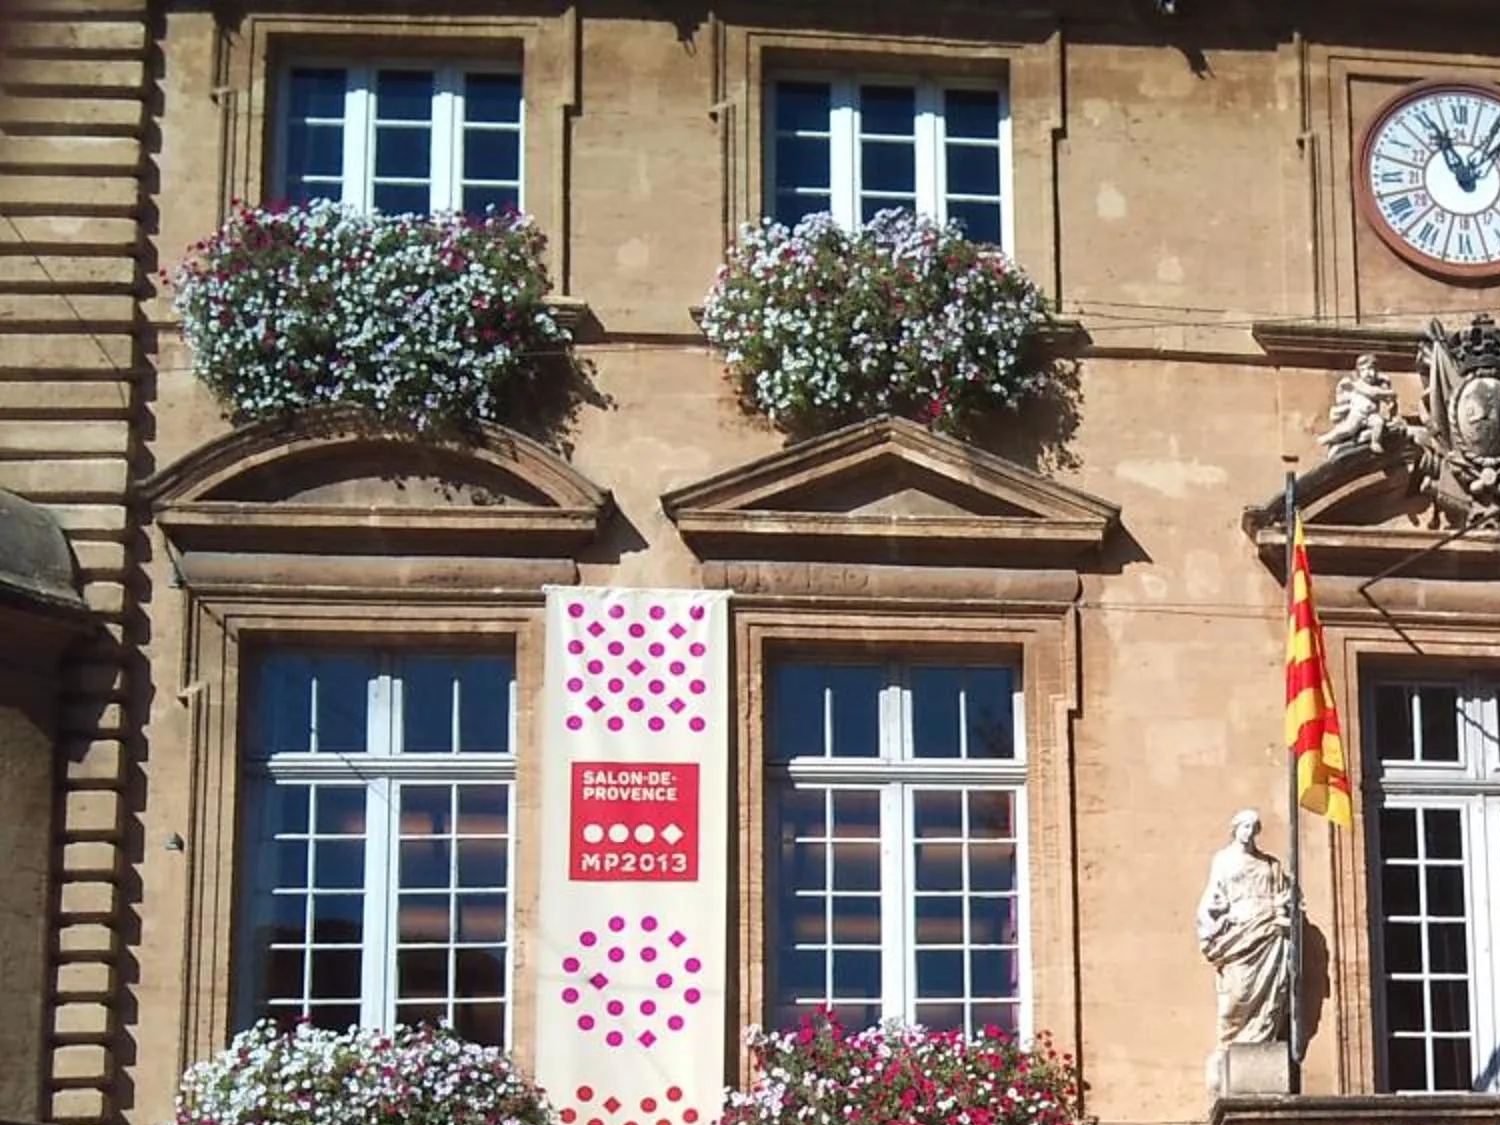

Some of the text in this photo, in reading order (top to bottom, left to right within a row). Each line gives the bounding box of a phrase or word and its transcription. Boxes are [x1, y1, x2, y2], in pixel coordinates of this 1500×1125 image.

[582, 770, 678, 785] SALON-DE-
[582, 787, 678, 801] PROVENCE
[581, 853, 687, 873] MP2013
